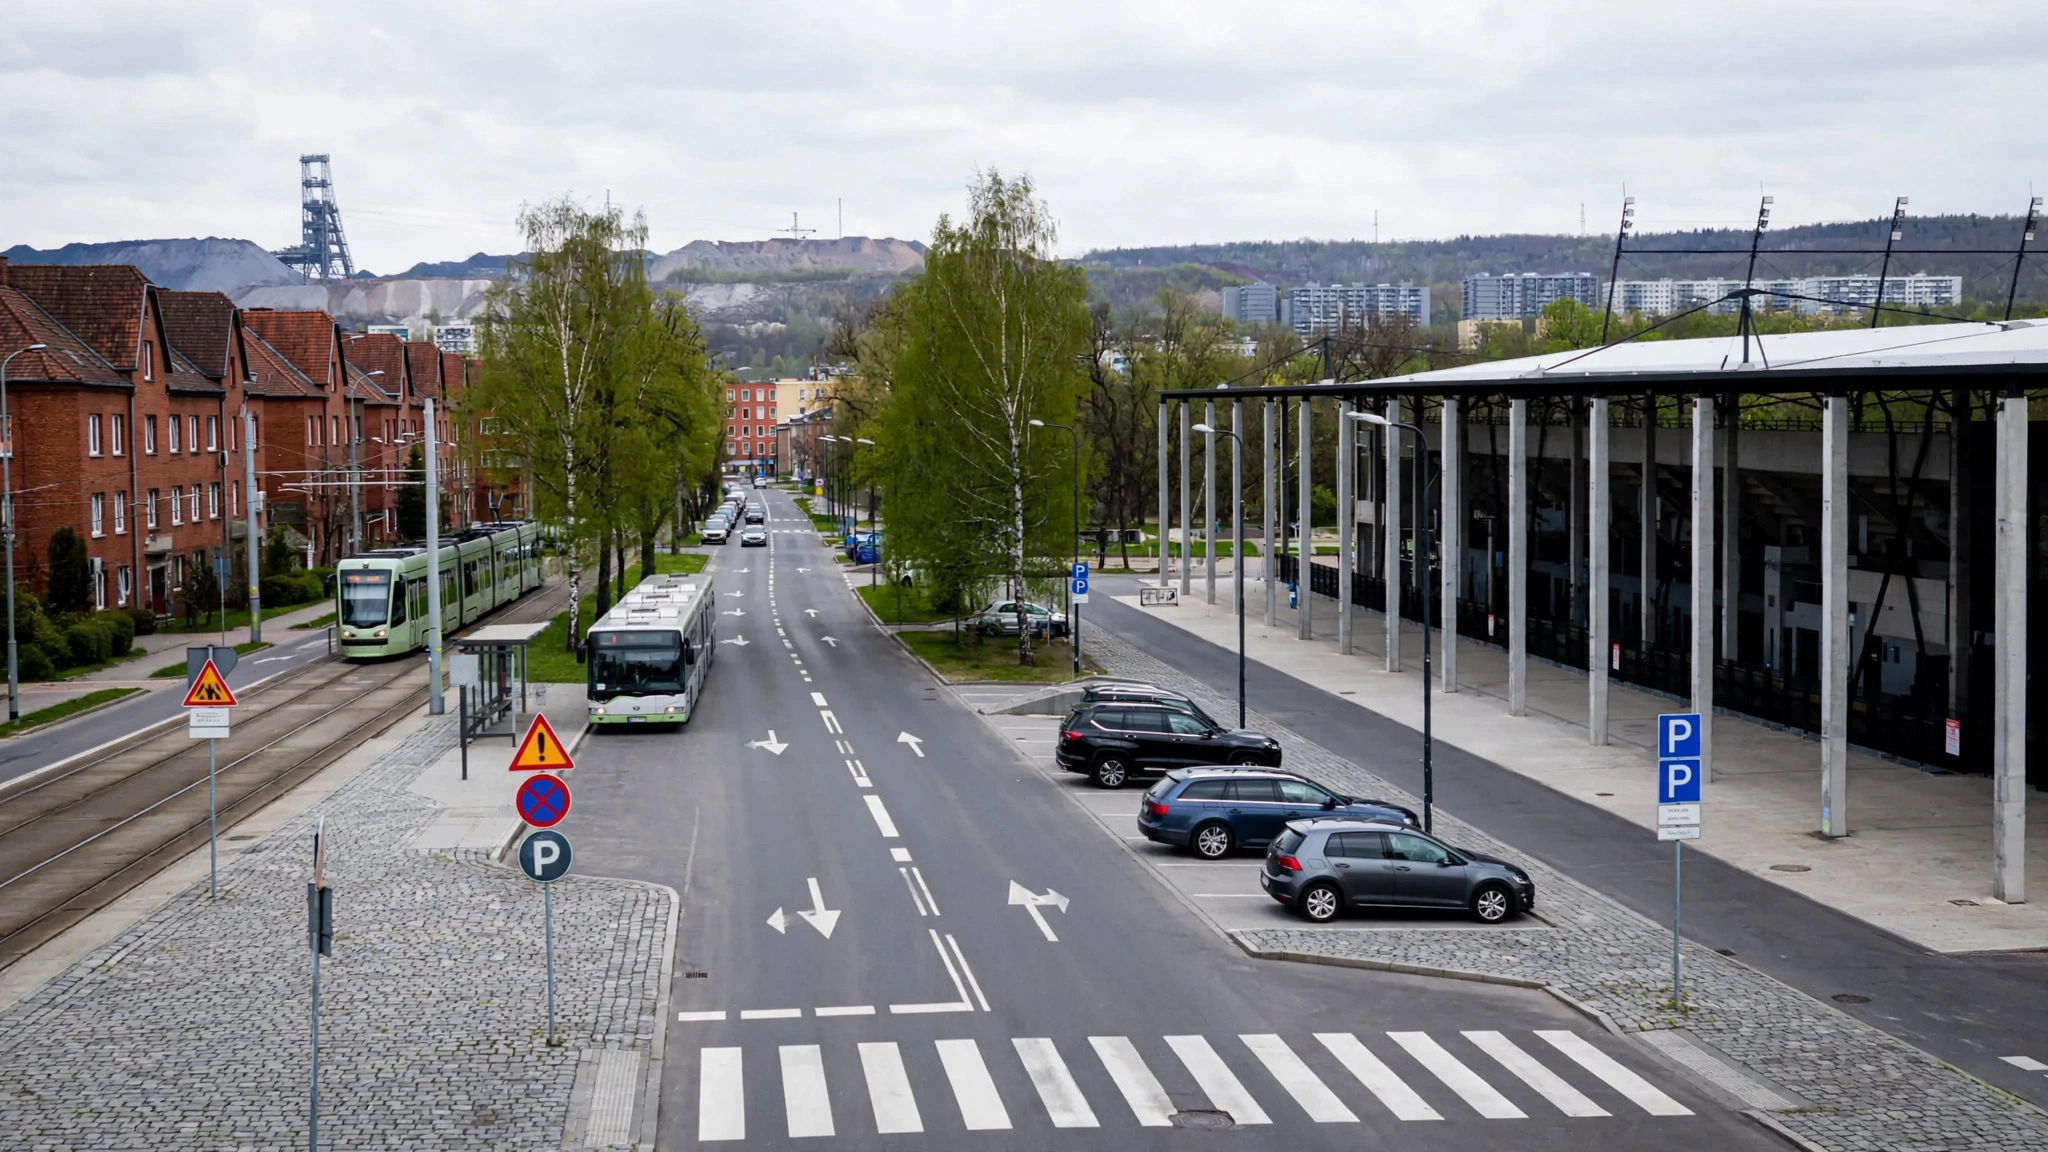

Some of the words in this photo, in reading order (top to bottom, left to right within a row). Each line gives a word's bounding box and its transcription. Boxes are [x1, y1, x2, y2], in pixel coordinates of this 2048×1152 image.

[1076, 565, 1085, 577] P
[1077, 581, 1085, 593] P
[1669, 719, 1692, 753] P
[1668, 764, 1692, 798] P
[534, 840, 560, 876] P
